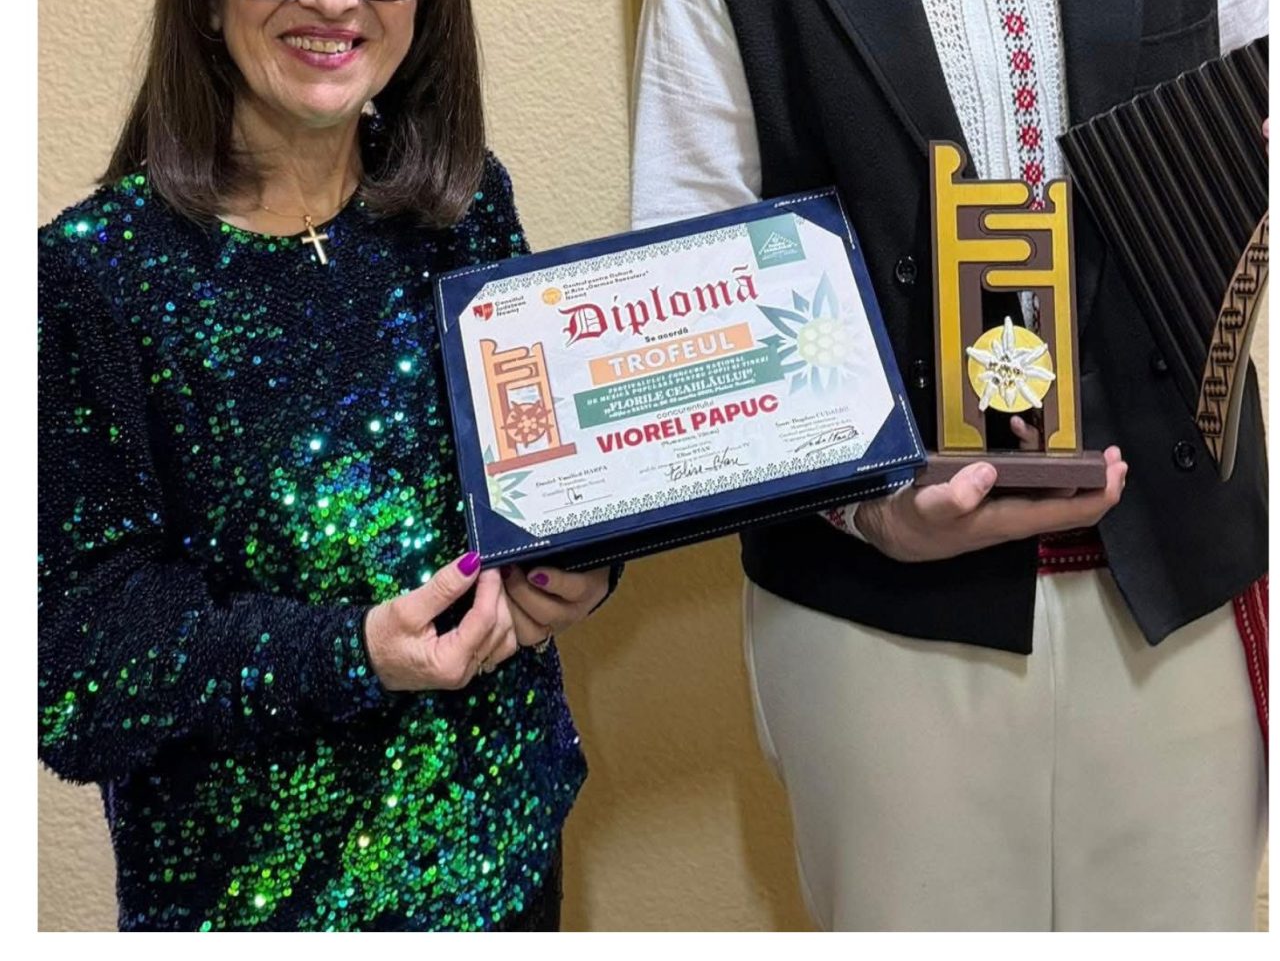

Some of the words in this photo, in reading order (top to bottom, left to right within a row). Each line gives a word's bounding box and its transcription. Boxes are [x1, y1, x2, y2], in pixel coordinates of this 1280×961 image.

[607, 330, 735, 377] TROFEUL
[596, 416, 686, 455] VIOREL
[689, 392, 780, 430] PAPUC
[655, 399, 715, 419] concurentului
